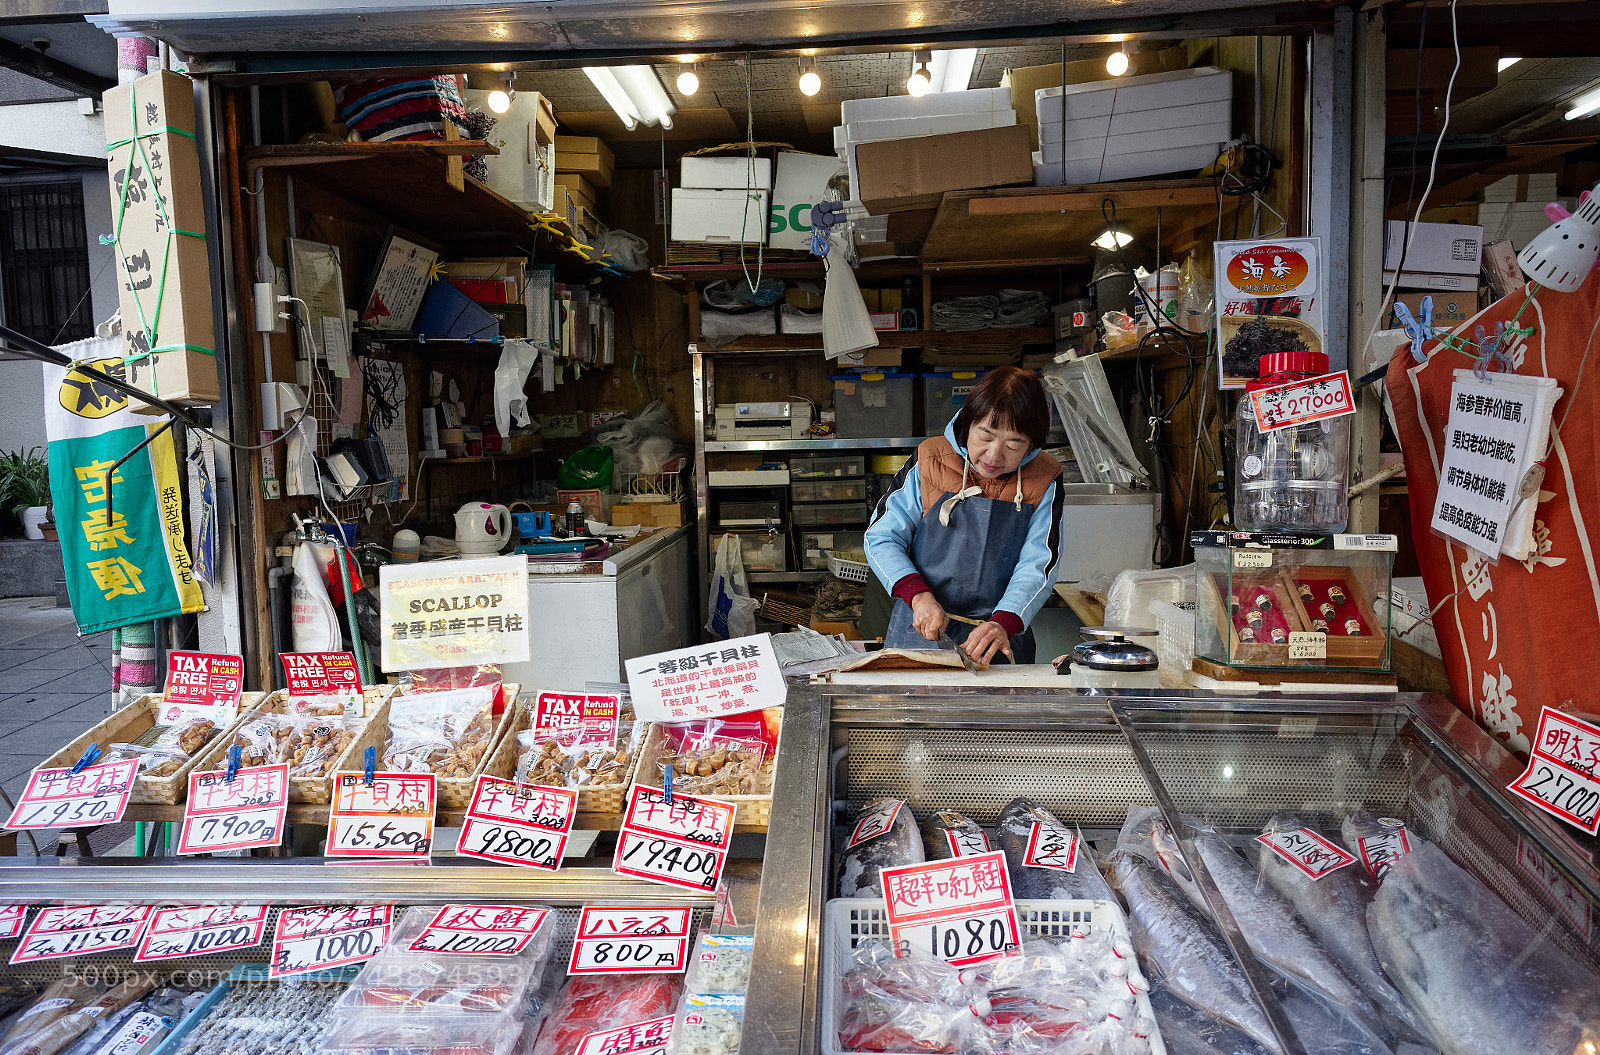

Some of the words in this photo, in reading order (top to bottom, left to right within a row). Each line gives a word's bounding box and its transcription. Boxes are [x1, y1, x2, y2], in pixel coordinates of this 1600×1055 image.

[74, 459, 146, 601] 宅急便
[1301, 537, 1315, 546] 300
[387, 576, 455, 590] SEASONING
[409, 594, 503, 614] SCALLOP
[173, 655, 209, 673] TAX
[211, 658, 240, 668] Refund
[284, 655, 323, 668] TAX
[321, 654, 350, 662] Refund
[334, 660, 353, 668] CASH
[637, 644, 761, 676] 一等級干貝柱
[211, 666, 220, 675] IN
[220, 667, 240, 675] CASH
[289, 666, 326, 679] FREE
[171, 671, 207, 686] FREE
[543, 698, 581, 715] TAX
[583, 700, 614, 709] Refund
[583, 708, 592, 716] IN
[592, 708, 614, 716] CASH
[541, 713, 579, 728] FREE
[443, 908, 531, 931] 秋鮭
[588, 915, 672, 935] ハラス
[593, 942, 675, 966] 800円
